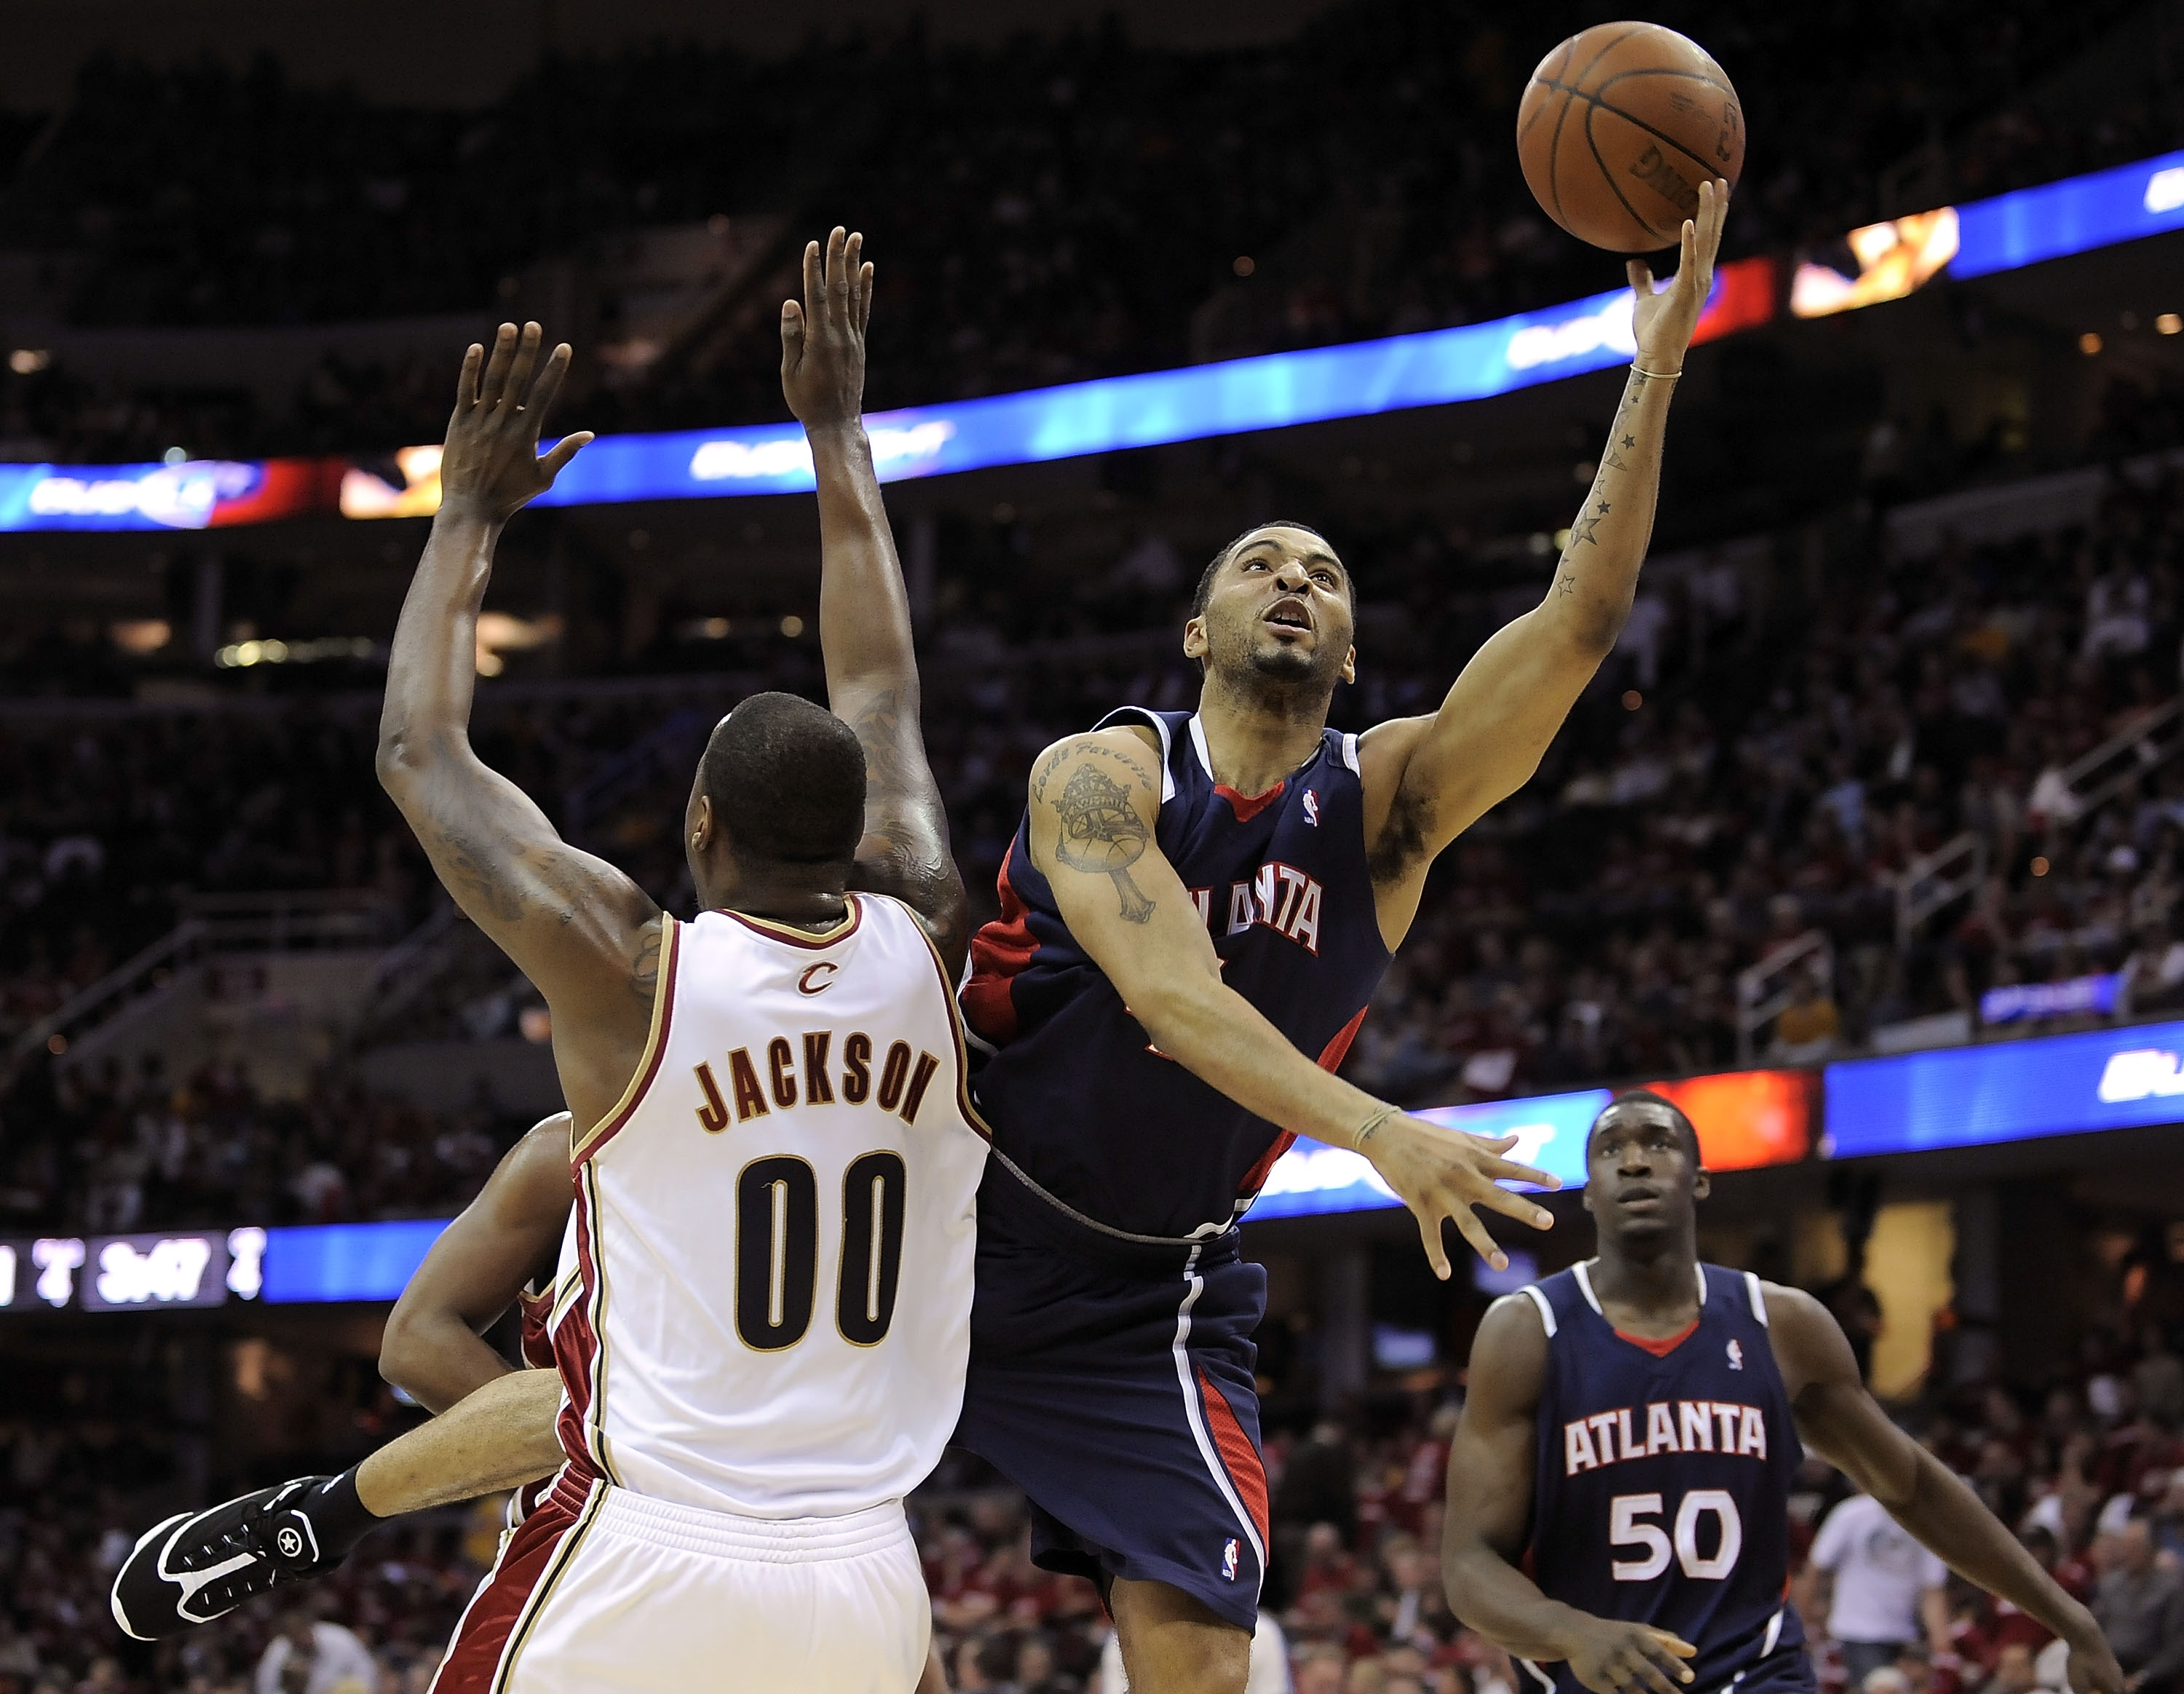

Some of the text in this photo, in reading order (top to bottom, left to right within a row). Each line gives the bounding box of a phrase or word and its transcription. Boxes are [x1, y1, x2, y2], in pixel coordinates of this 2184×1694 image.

[693, 1030, 941, 1135] JACKSON
[735, 1149, 908, 1353] 00
[1564, 1401, 1767, 1477] ATLANTA
[1610, 1489, 1742, 1580] 50
